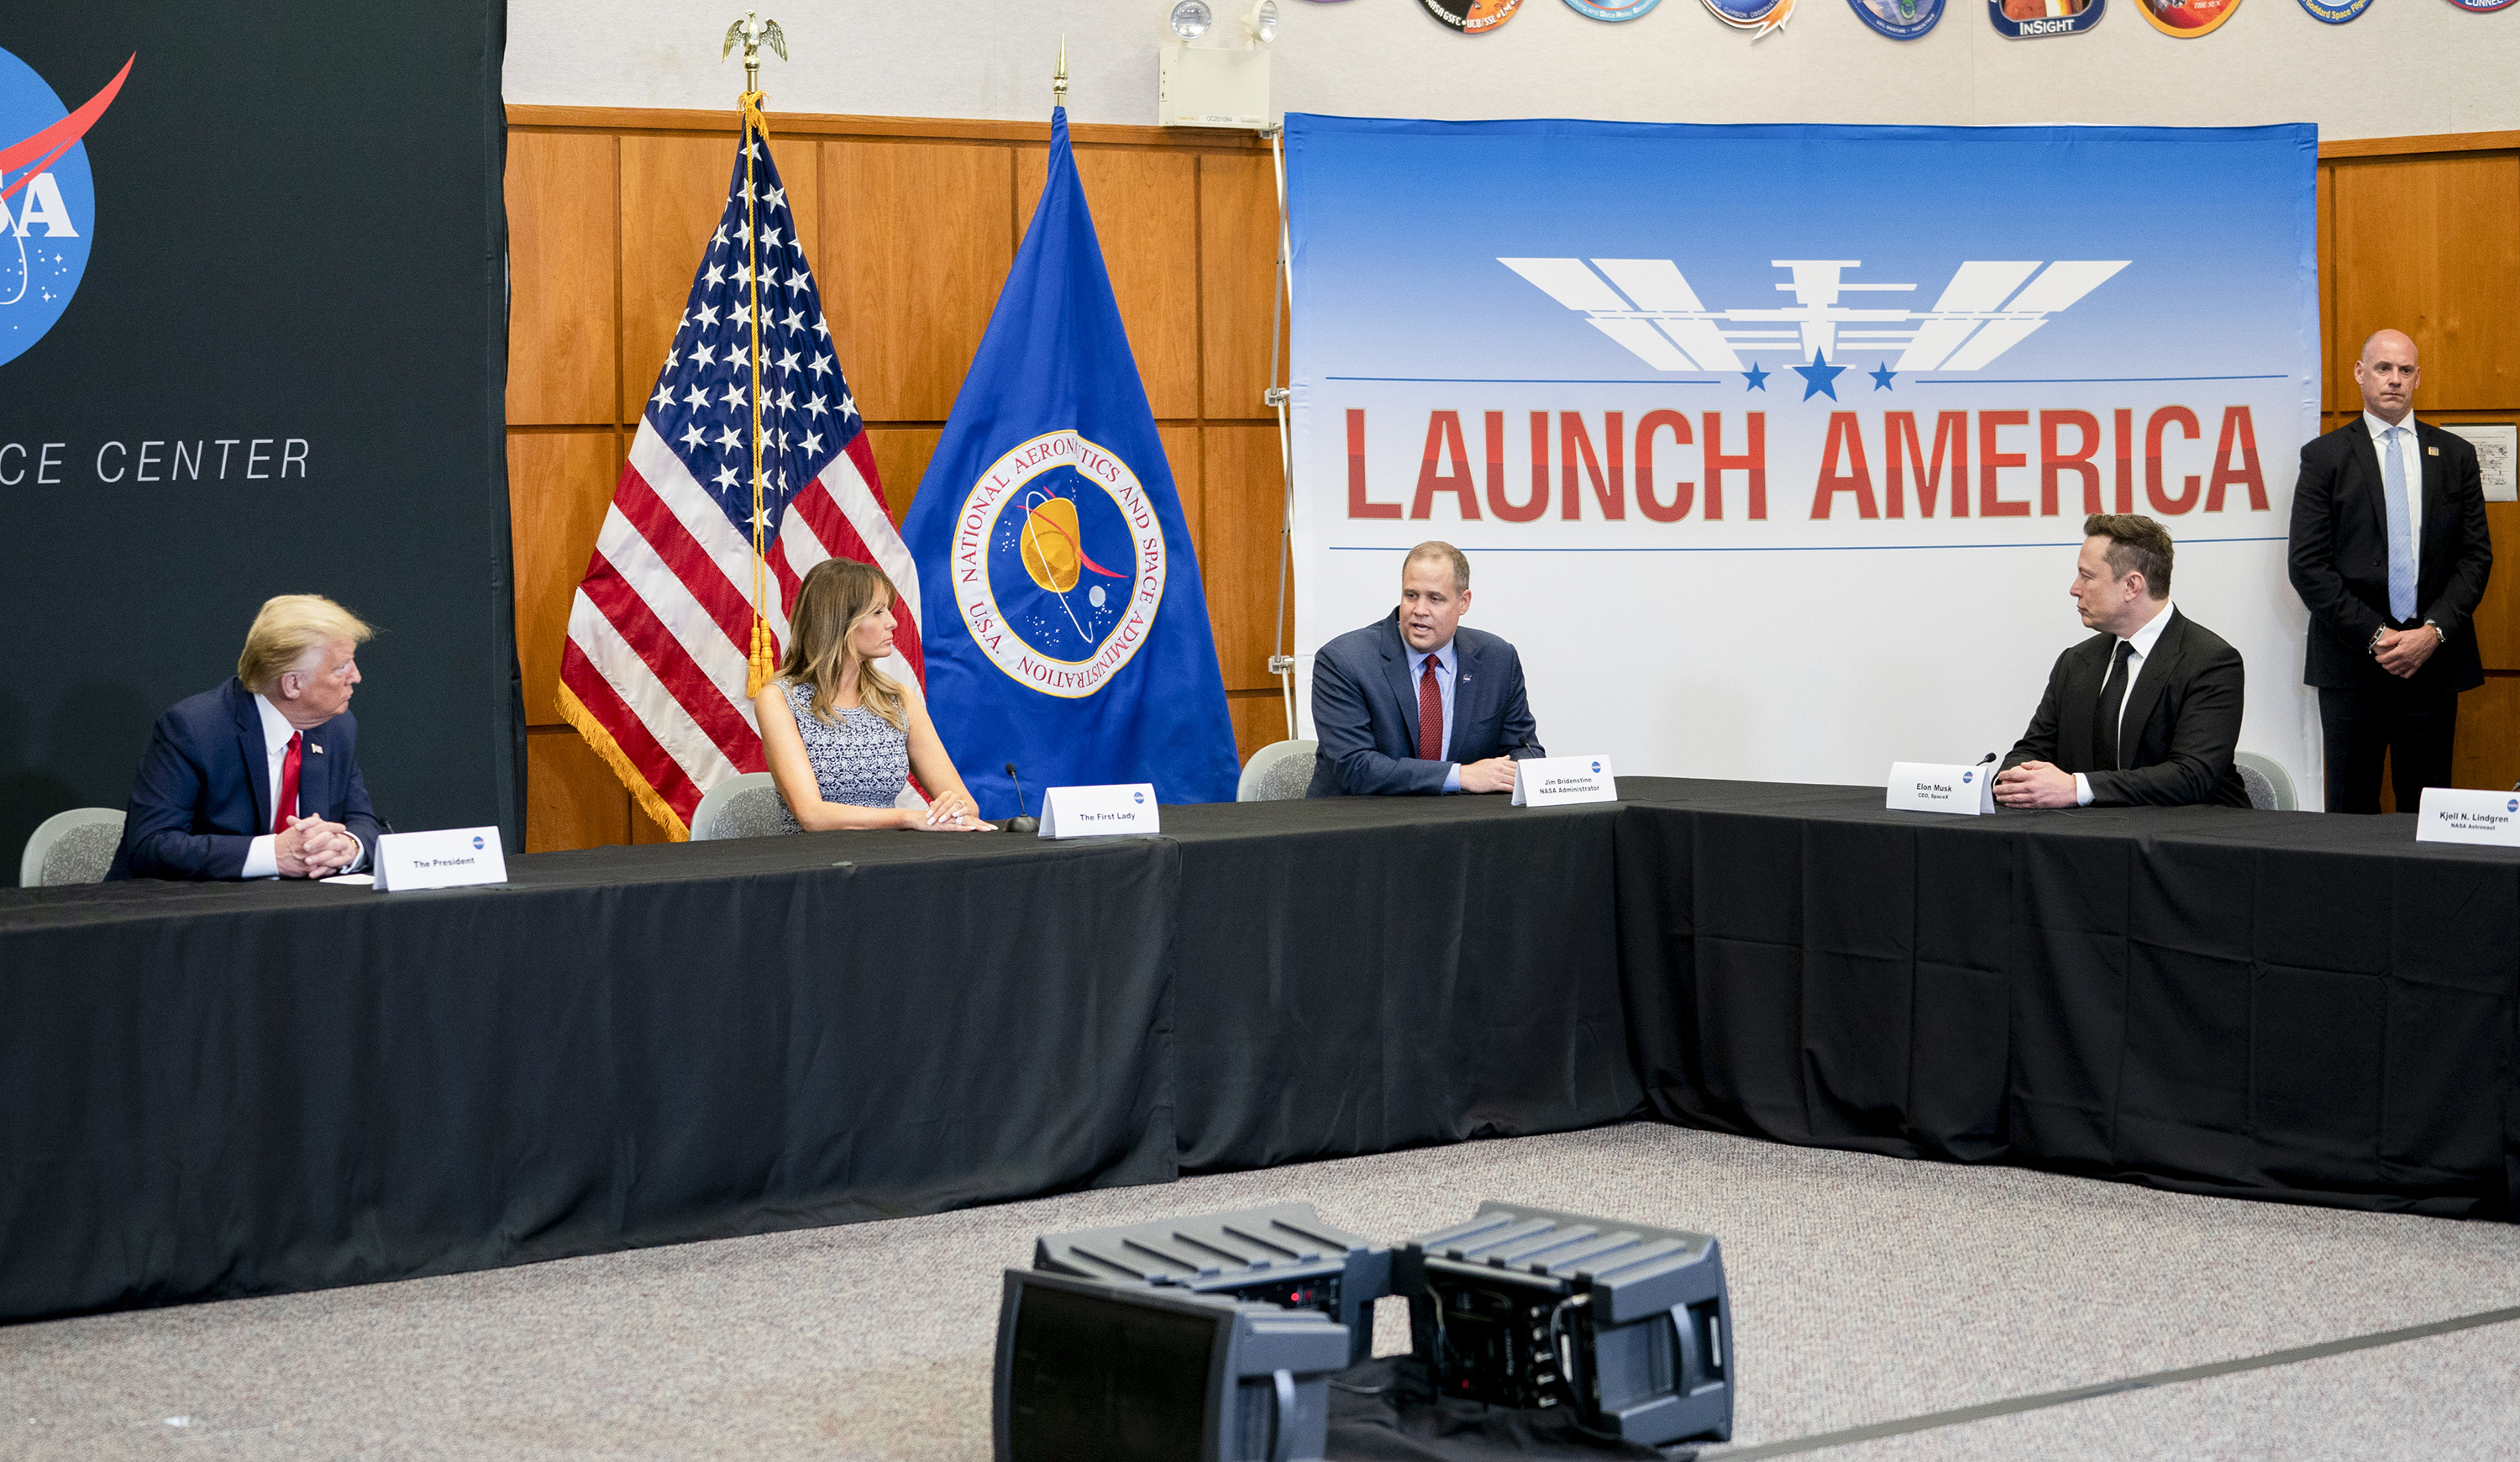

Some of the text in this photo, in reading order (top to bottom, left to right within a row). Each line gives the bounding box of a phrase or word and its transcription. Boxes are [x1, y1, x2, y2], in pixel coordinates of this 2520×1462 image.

[1425, 0, 1444, 17] NASA
[1443, 11, 1462, 26] GSFC
[1588, 8, 1599, 16] and
[1616, 10, 1632, 18] Relay
[1724, 7, 1747, 18] CARBON
[2306, 0, 2331, 18] Goddard
[2332, 9, 2351, 20] Space
[0, 169, 80, 237] A
[0, 439, 309, 486] CE CENTER
[1346, 404, 2271, 523] LAUNCH AMERICA
[1119, 486, 1150, 529] AND
[961, 474, 1011, 584] NATIONAL
[1140, 538, 1158, 605] SPACE
[969, 602, 1002, 655] U.S.A.
[1017, 611, 1144, 689] ADMINISTRATION
[1557, 777, 1592, 786] Bridenstine
[1558, 786, 1599, 794] Administrator
[1116, 813, 1136, 821] Lady
[2439, 812, 2459, 821] Kjell
[2472, 814, 2509, 823] Lindgren
[414, 857, 475, 869] The President
